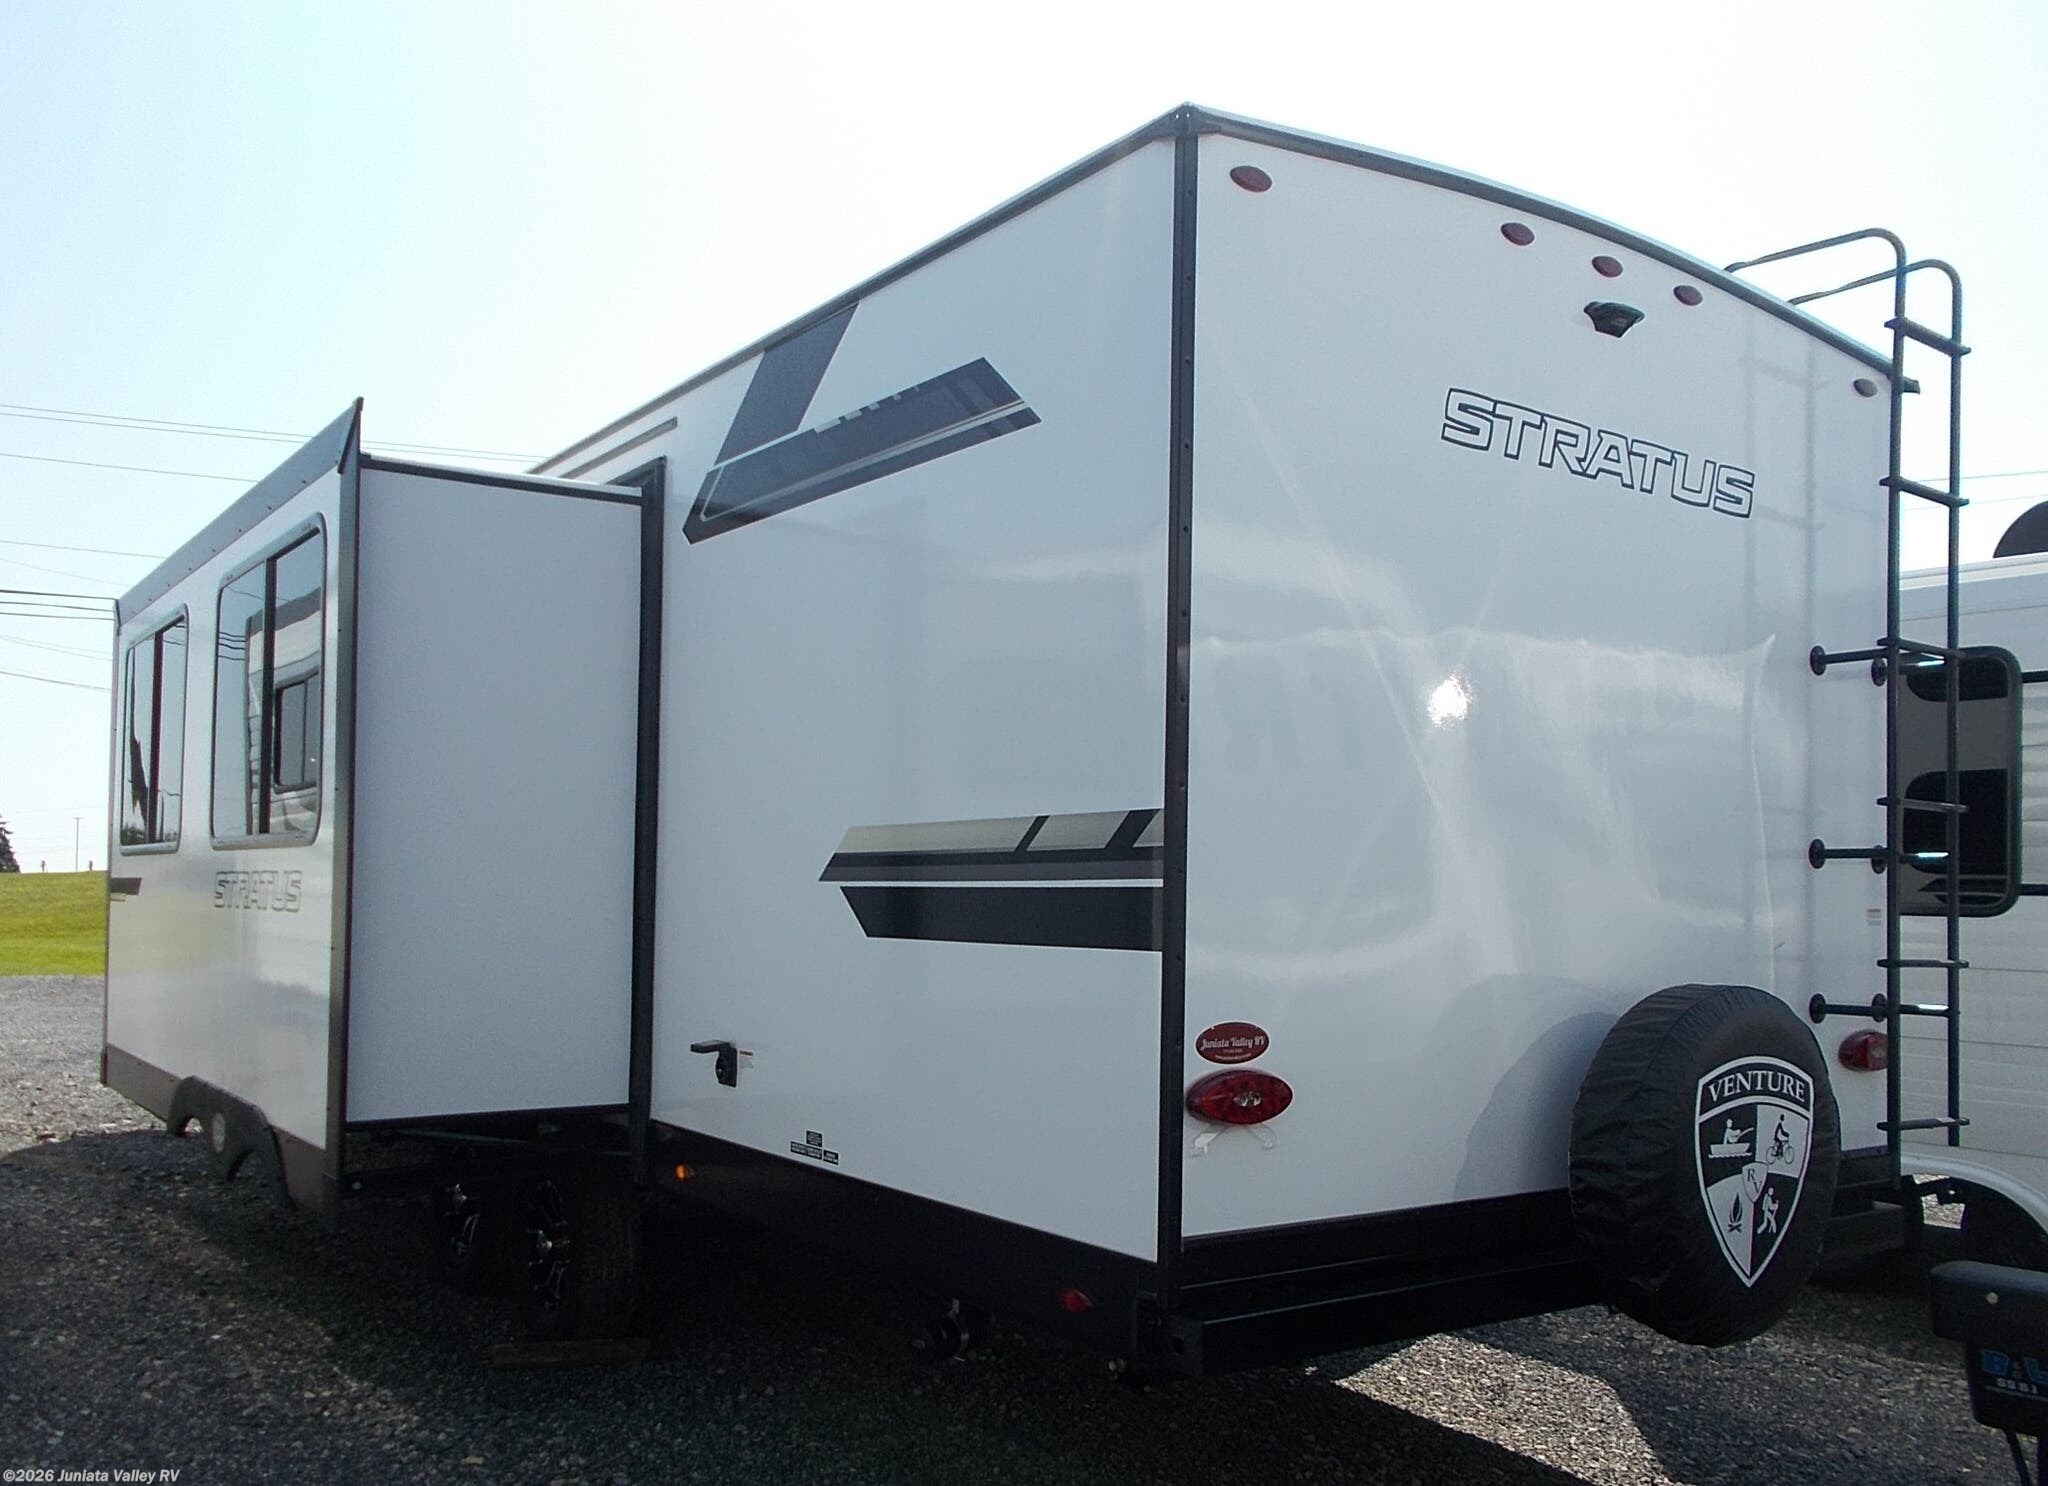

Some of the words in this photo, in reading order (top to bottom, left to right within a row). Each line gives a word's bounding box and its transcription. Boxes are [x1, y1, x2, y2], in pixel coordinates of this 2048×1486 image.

[1441, 387, 1755, 519] STRATUS
[214, 870, 302, 912] STRATUS
[1708, 1070, 1805, 1103] VENTURE
